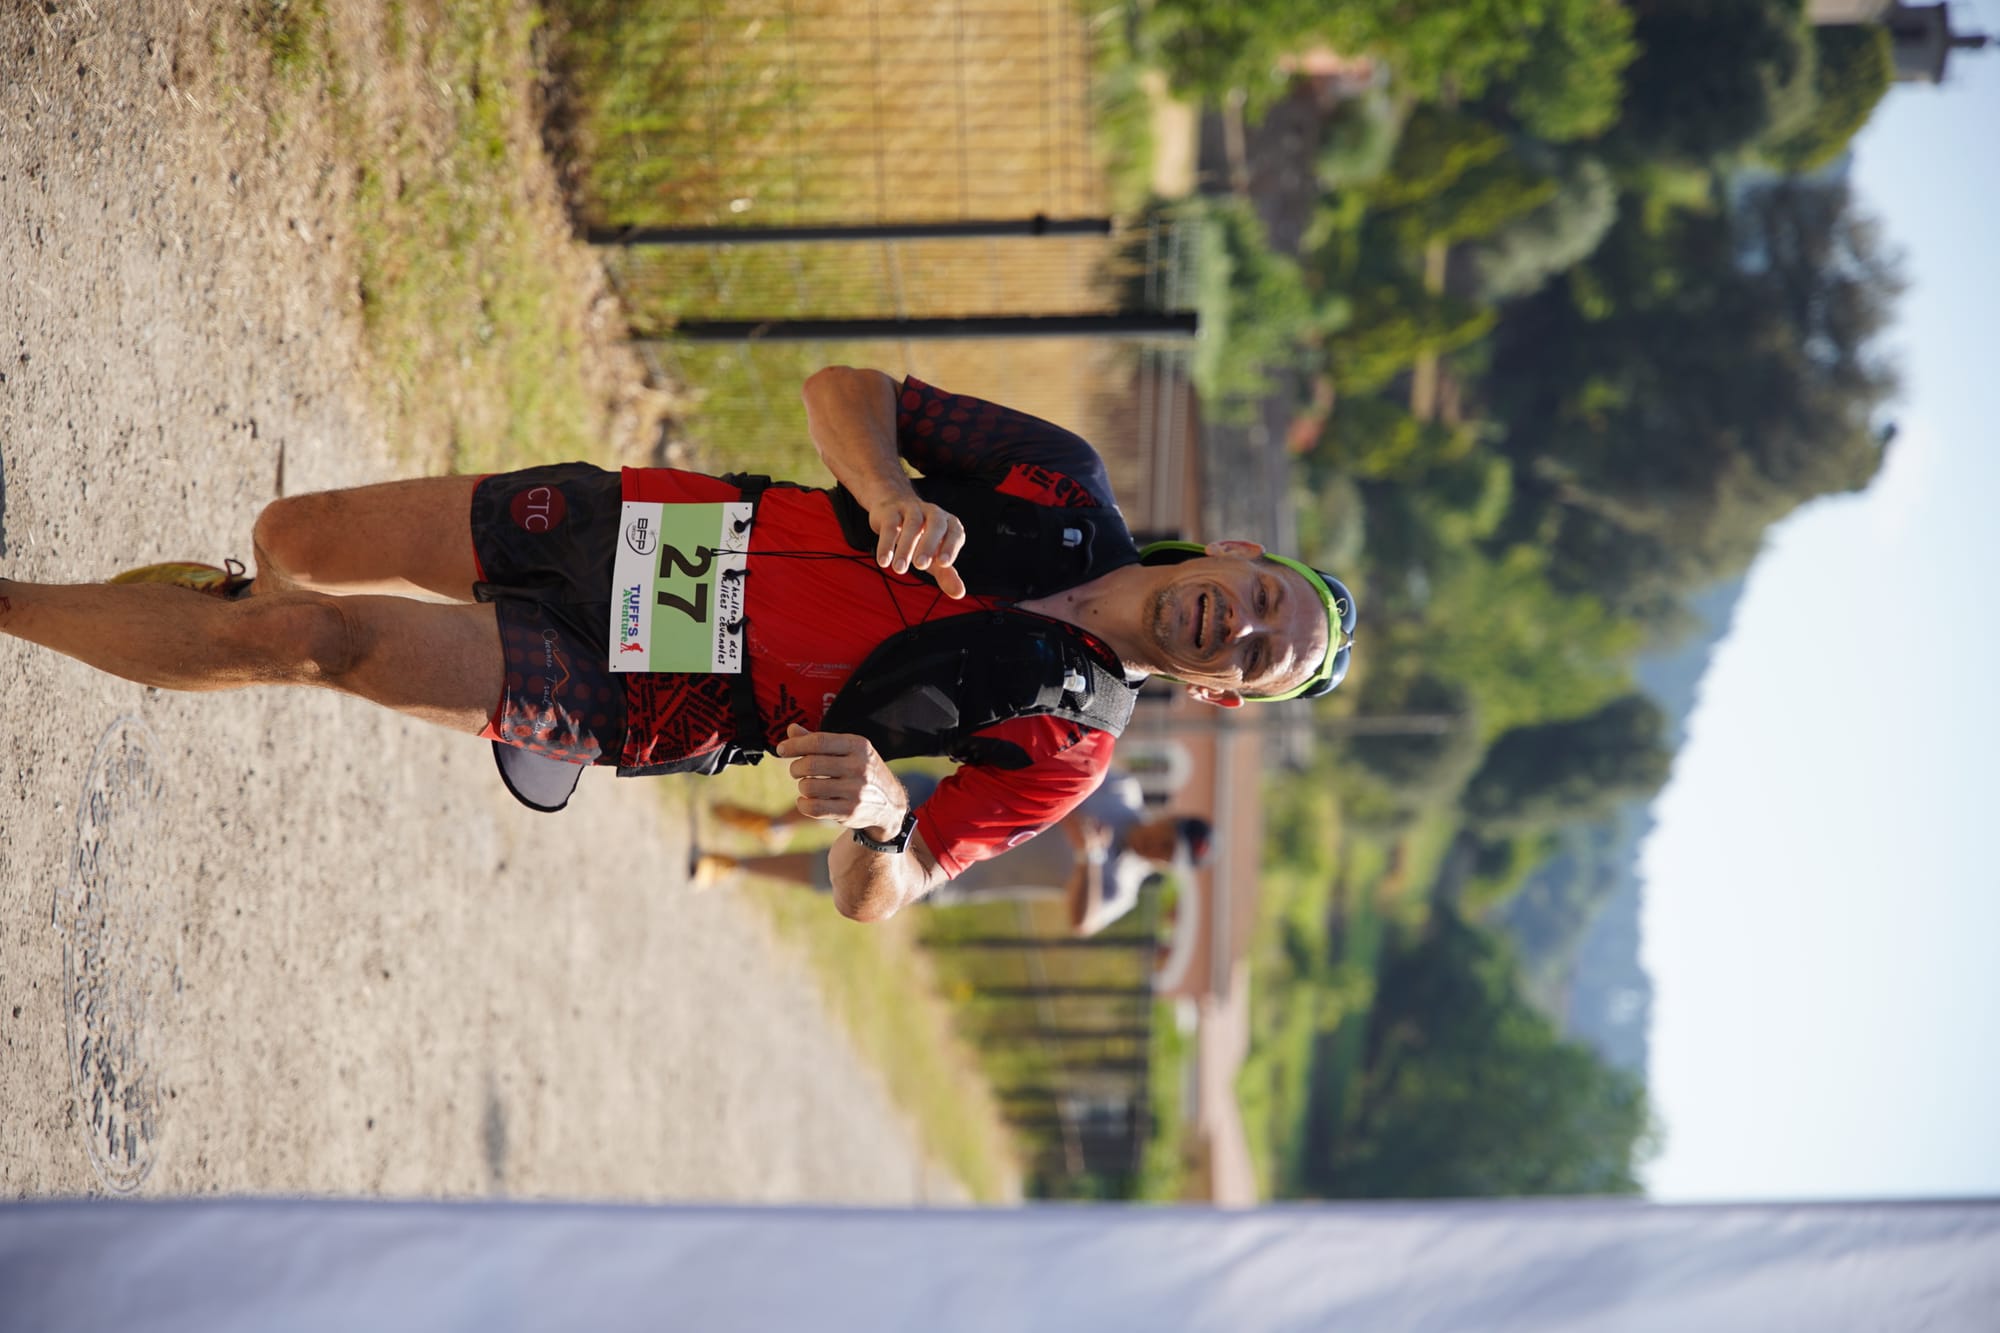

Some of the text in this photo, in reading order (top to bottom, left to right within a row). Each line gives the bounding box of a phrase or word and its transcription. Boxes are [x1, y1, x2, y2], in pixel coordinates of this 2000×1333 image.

[524, 487, 551, 530] CTC
[635, 518, 648, 550] BFP
[656, 544, 712, 623] 27
[620, 589, 631, 642] Aventure
[628, 584, 641, 637] TUFF'S
[718, 572, 730, 665] allées cévenoles
[726, 578, 740, 660] Challen des
